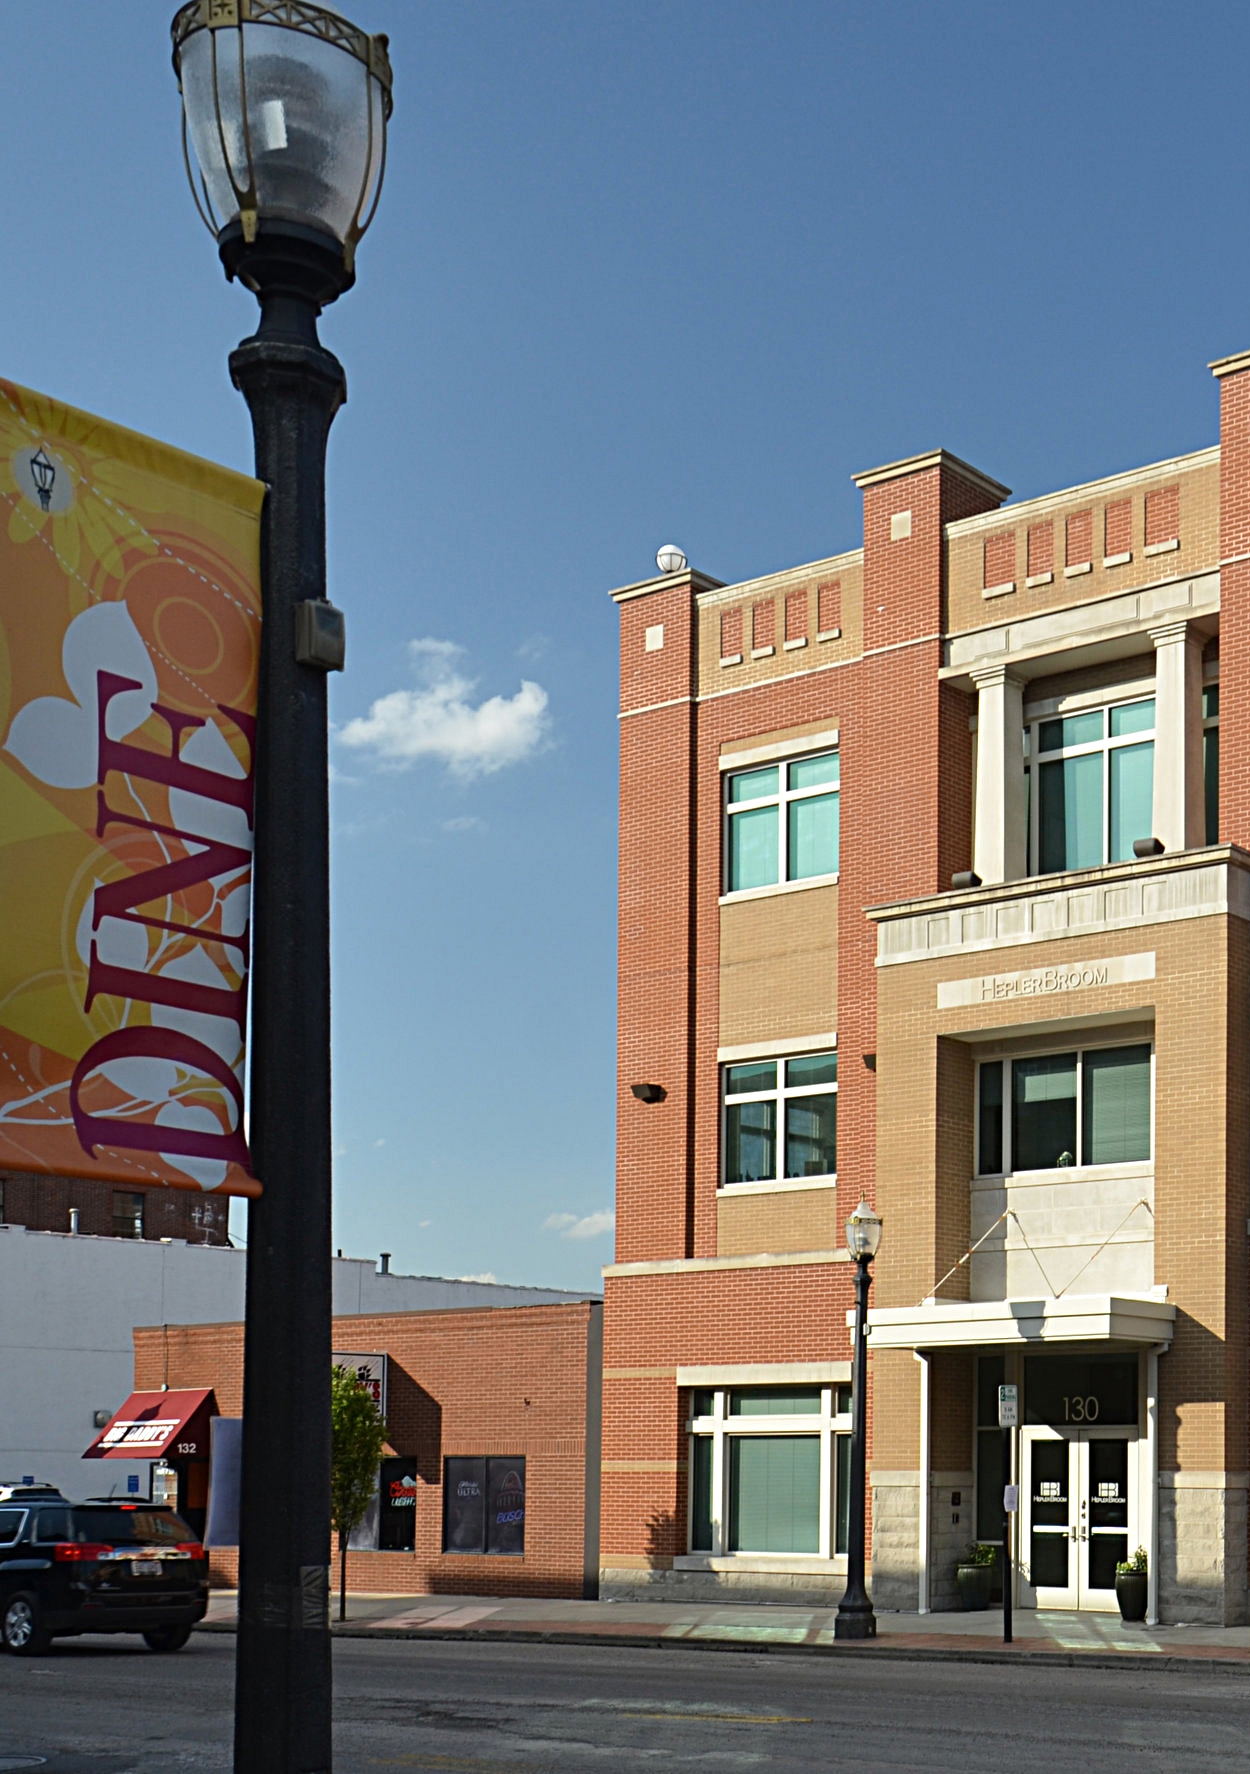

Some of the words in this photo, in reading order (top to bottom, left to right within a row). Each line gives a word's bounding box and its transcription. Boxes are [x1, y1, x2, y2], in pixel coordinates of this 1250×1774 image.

[71, 669, 257, 1172] DINE
[1063, 1395, 1099, 1422] 130
[177, 1443, 197, 1454] 132
[457, 1488, 481, 1497] ULTRA
